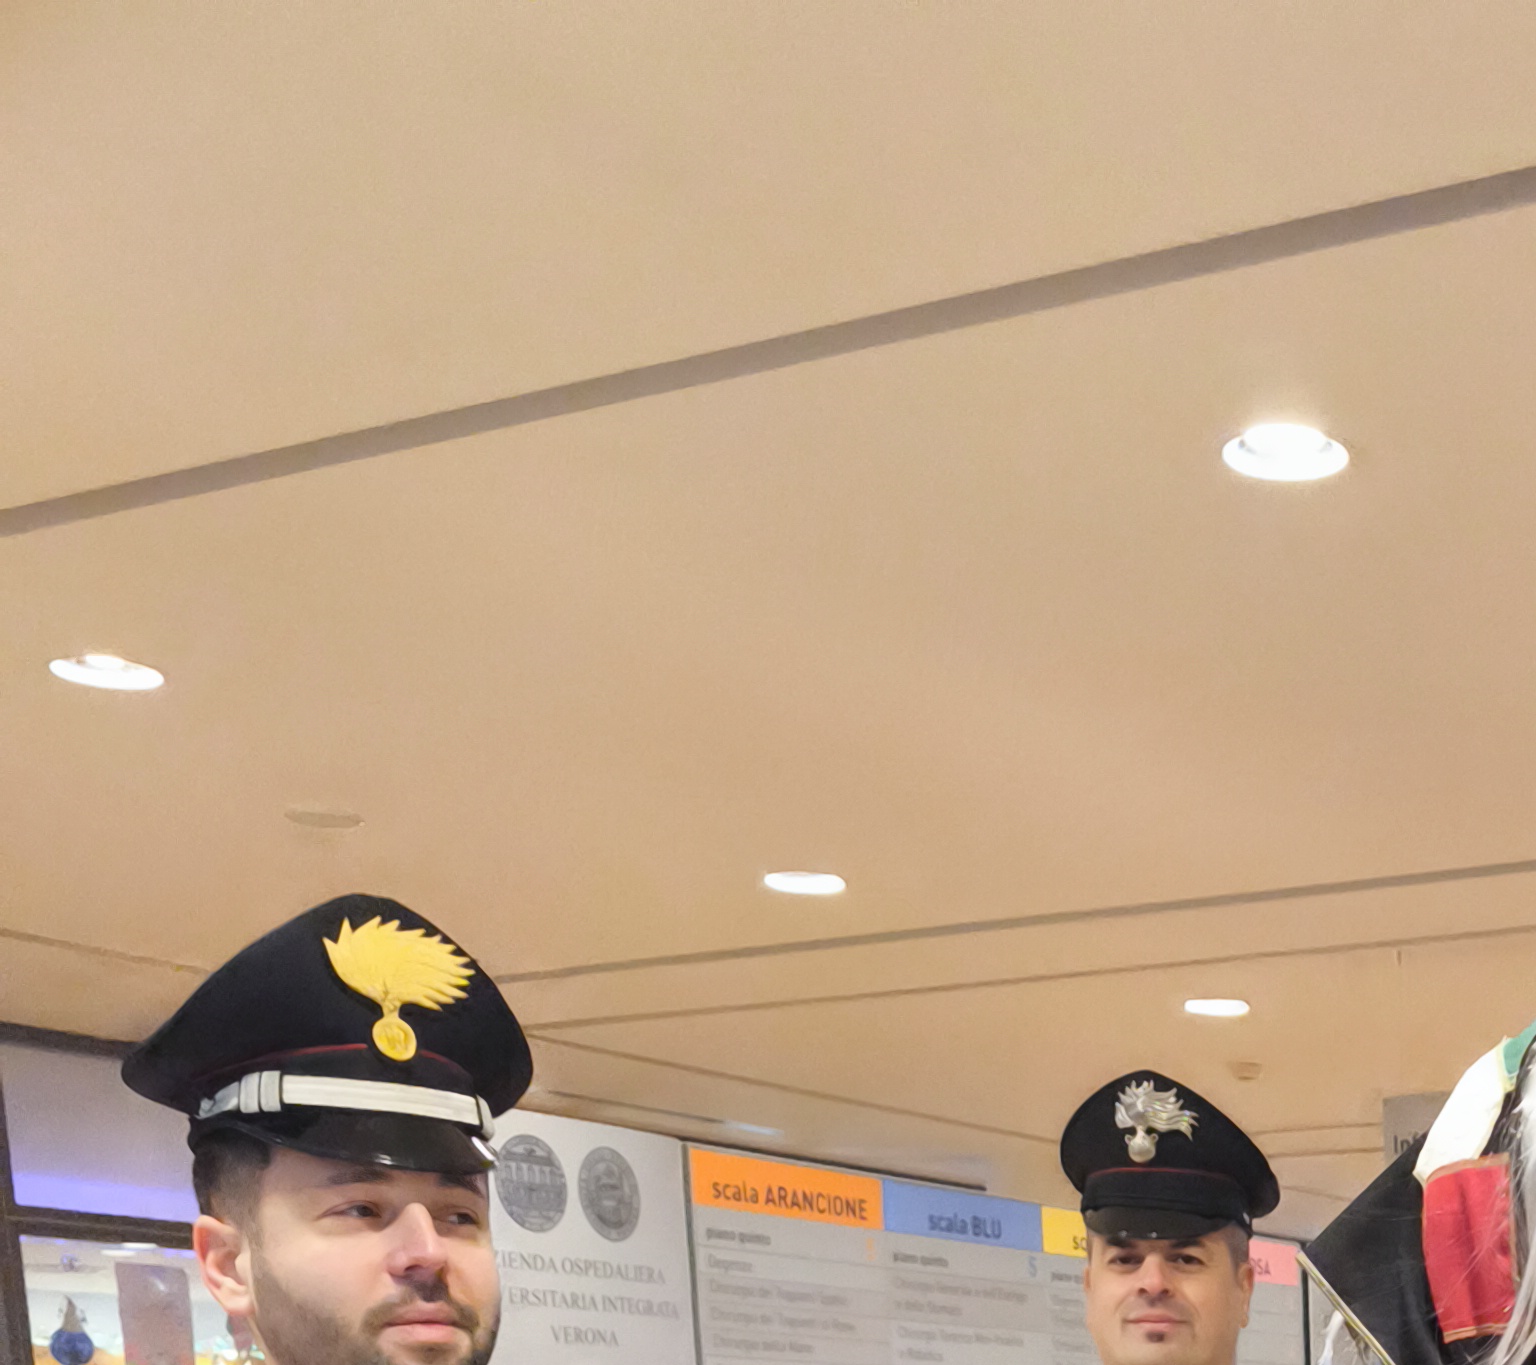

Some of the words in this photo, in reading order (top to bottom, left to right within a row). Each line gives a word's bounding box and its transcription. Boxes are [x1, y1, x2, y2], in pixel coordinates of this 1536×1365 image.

[712, 1180, 760, 1204] scala
[763, 1184, 869, 1222] ARANCIONE
[927, 1213, 969, 1237] scala
[971, 1216, 1003, 1240] BLU
[495, 1249, 559, 1274] IENDA
[562, 1256, 667, 1285] OSPEDALIERA
[1249, 1256, 1272, 1277] OSA
[508, 1285, 601, 1312] ERSITARIA
[602, 1297, 679, 1319] INTEGRATA
[550, 1324, 619, 1347] VERONA
